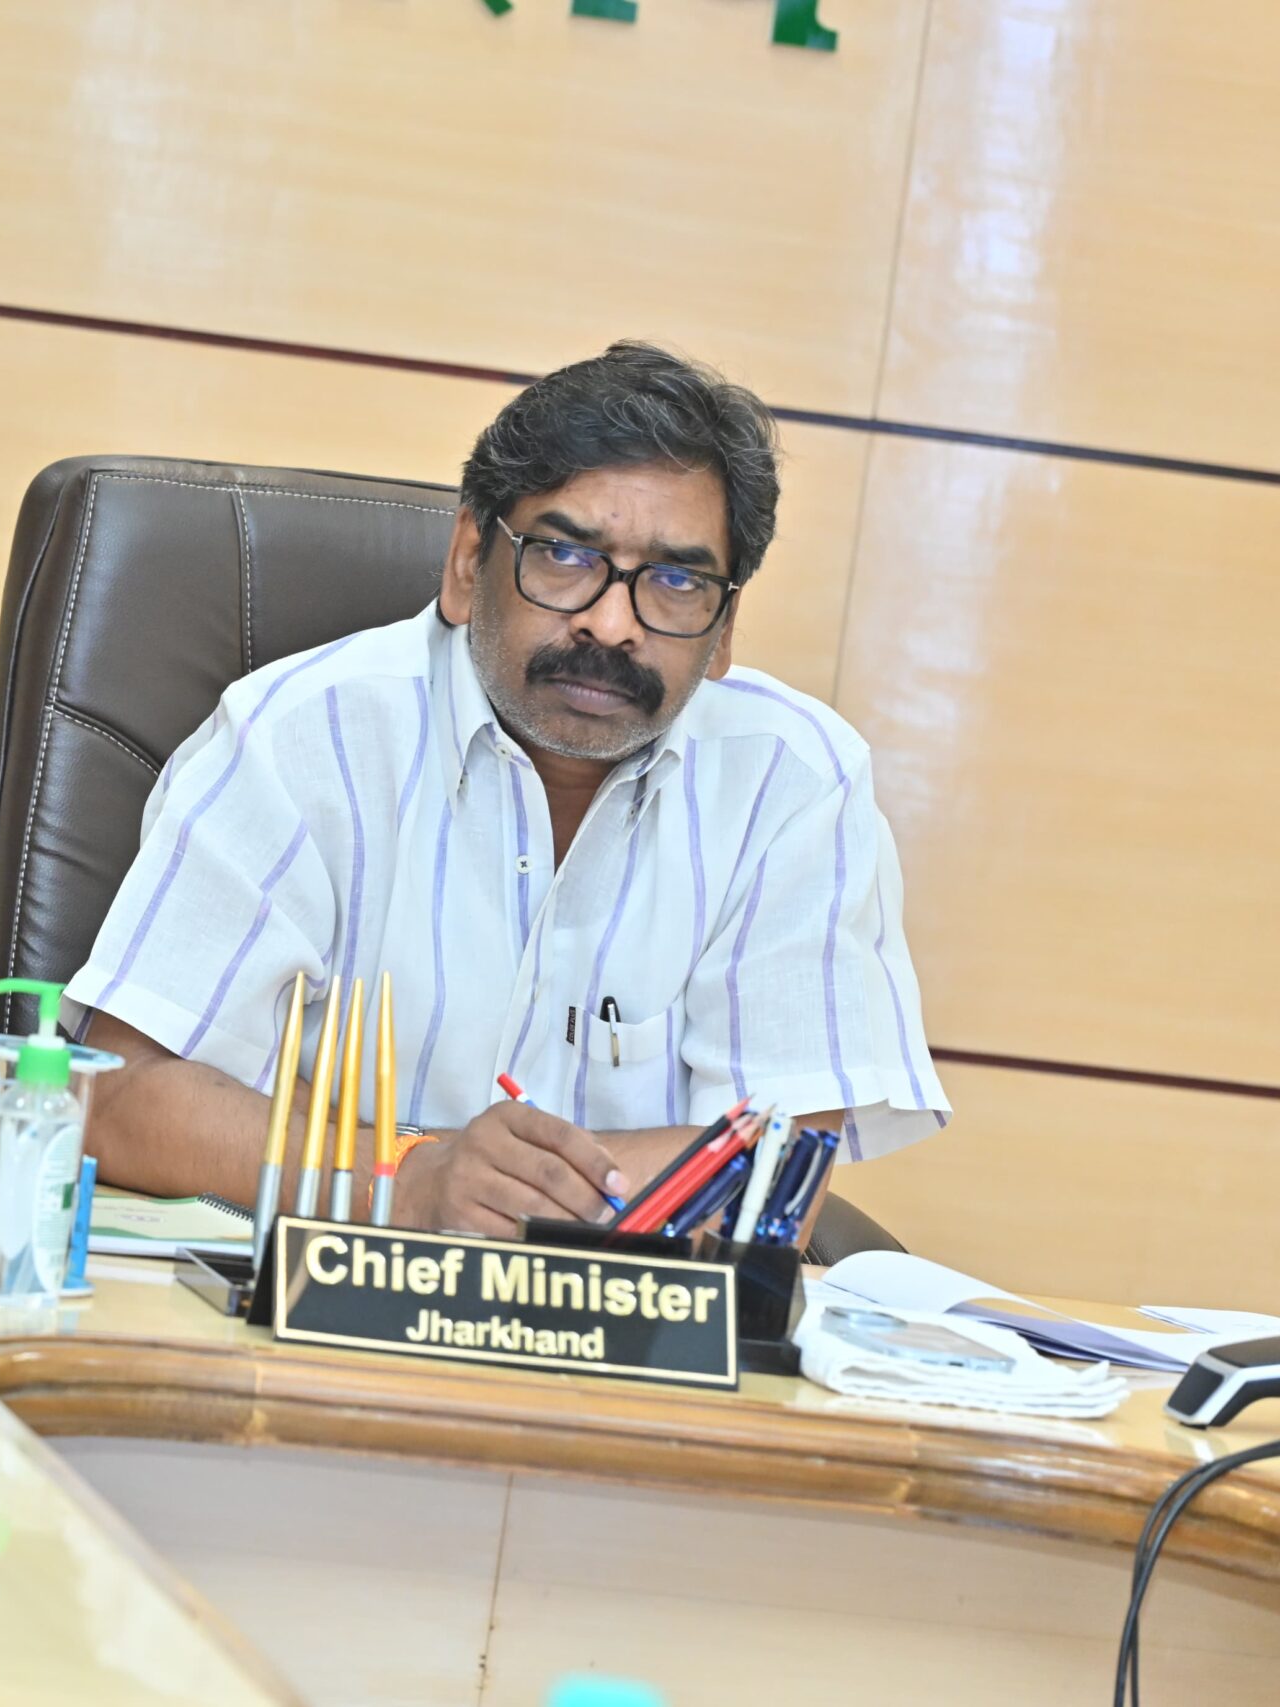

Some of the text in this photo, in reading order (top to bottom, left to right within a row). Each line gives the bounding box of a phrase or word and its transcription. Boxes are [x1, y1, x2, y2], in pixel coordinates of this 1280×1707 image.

[305, 1234, 719, 1323] Chief Minister
[406, 1309, 606, 1361] Jharkhand
